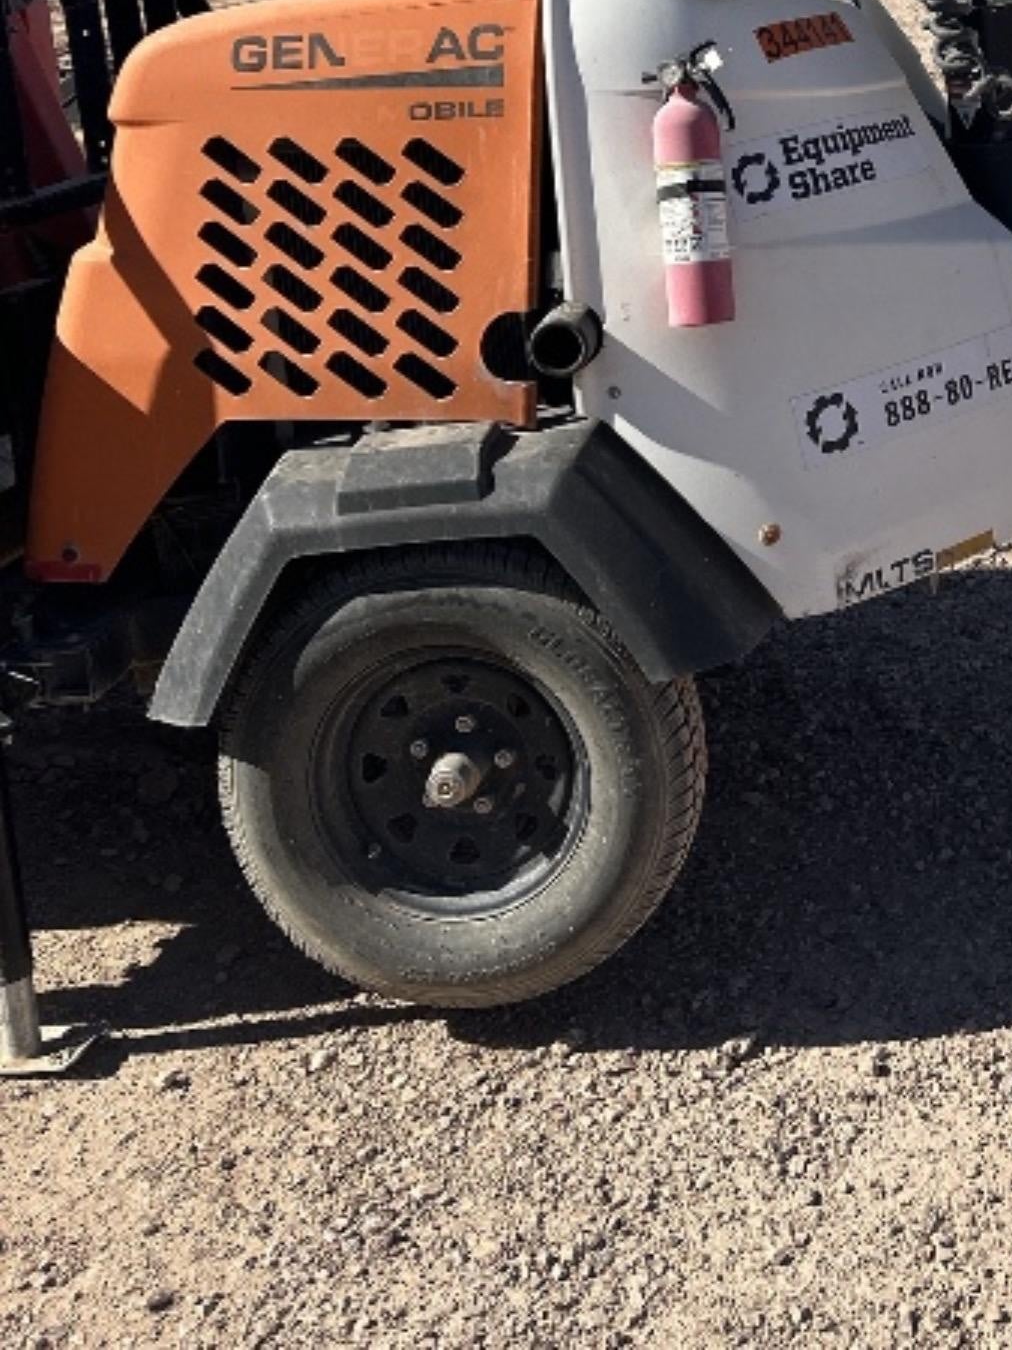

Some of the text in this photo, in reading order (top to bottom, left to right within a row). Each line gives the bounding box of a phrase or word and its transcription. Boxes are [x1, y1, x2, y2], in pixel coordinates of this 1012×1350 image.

[231, 24, 505, 73] GENAC
[378, 98, 505, 122] OBILE
[779, 114, 916, 166] Equipment
[788, 157, 877, 200] Share
